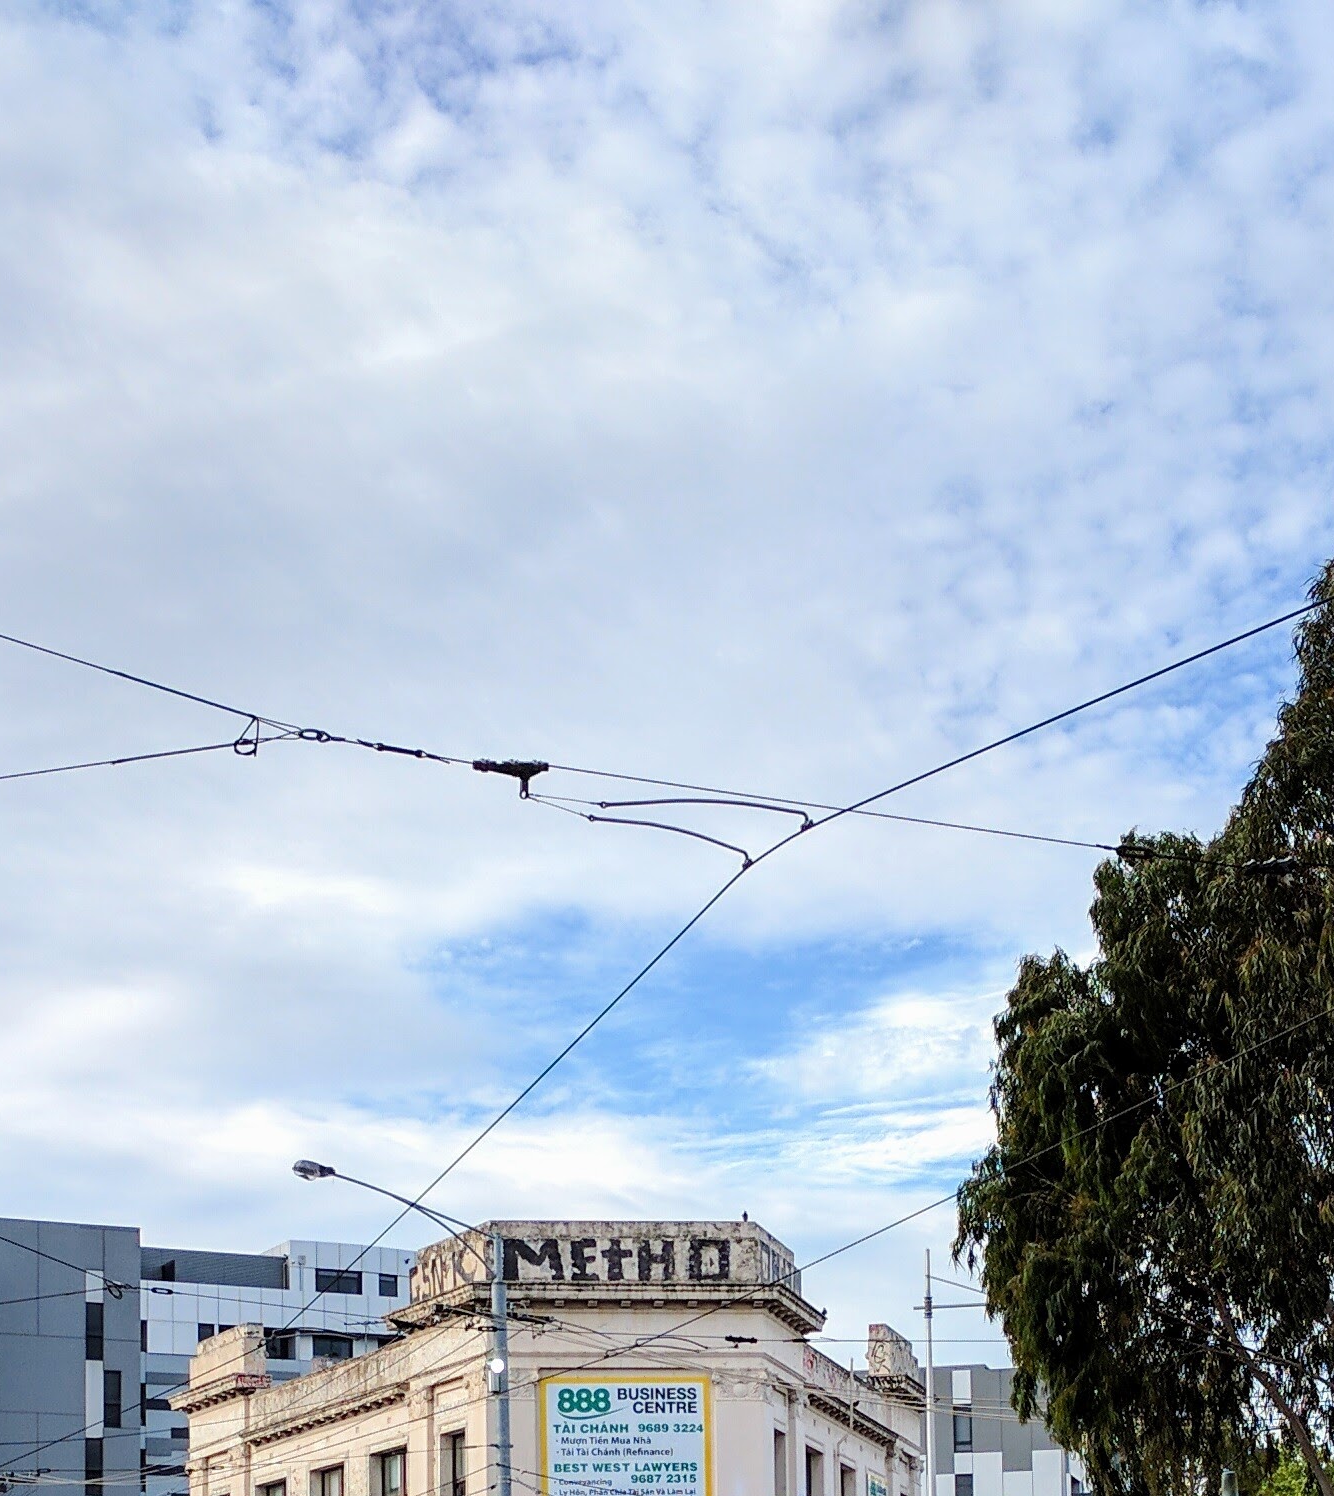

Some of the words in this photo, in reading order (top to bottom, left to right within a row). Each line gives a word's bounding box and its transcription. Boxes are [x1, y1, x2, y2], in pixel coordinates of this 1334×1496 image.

[557, 1388, 611, 1413] 888
[617, 1387, 697, 1401] BUSINESS
[633, 1401, 698, 1414] CENTRE
[580, 1421, 629, 1434] CHÁNH
[638, 1423, 669, 1433] 9689
[673, 1423, 704, 1433] 3224
[611, 1437, 631, 1445] Mua
[623, 1448, 674, 1457] (Refinance)
[554, 1463, 588, 1473] BEST
[592, 1463, 630, 1472] WEST
[635, 1462, 698, 1472] LAWYERS
[631, 1474, 662, 1484] 9687
[666, 1474, 697, 1483] 2315
